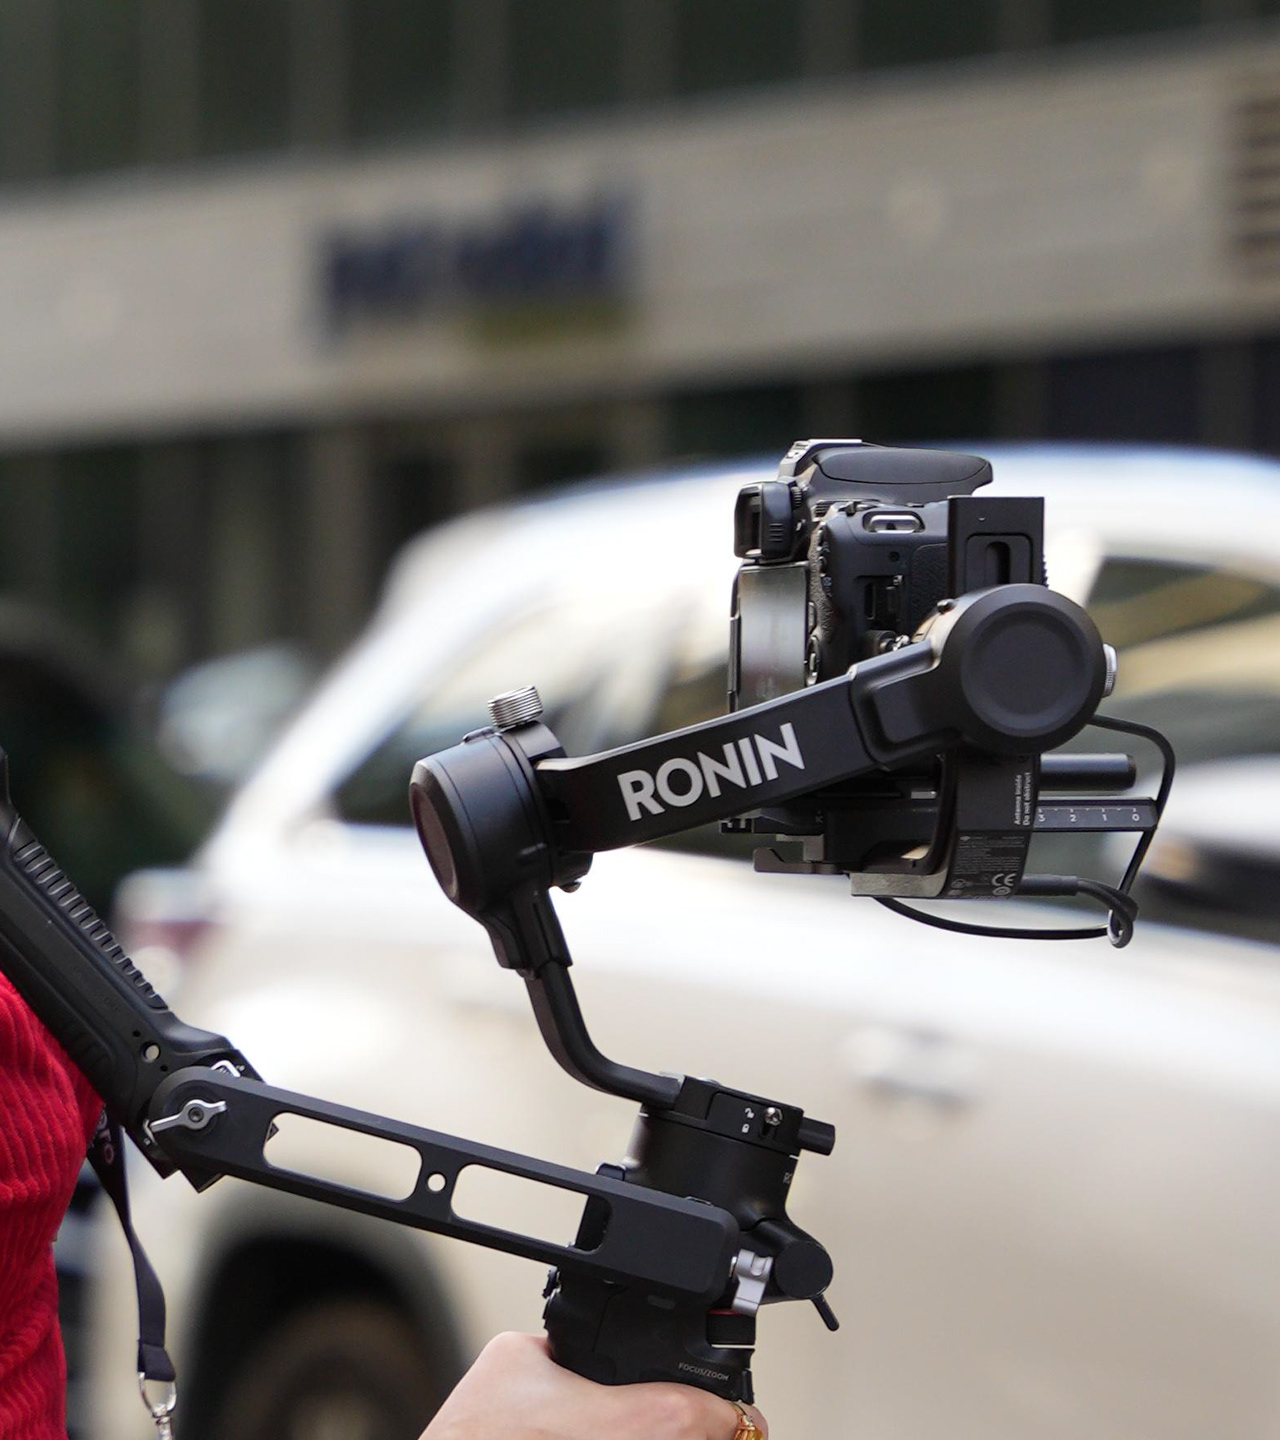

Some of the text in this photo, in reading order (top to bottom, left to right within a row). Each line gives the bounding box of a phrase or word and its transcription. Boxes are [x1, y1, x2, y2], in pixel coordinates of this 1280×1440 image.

[617, 722, 805, 821] RONIN
[1038, 813, 1140, 822] 3 2 1 0
[991, 873, 1015, 886] CE
[678, 1362, 730, 1381] FOCUS/ZOOM
